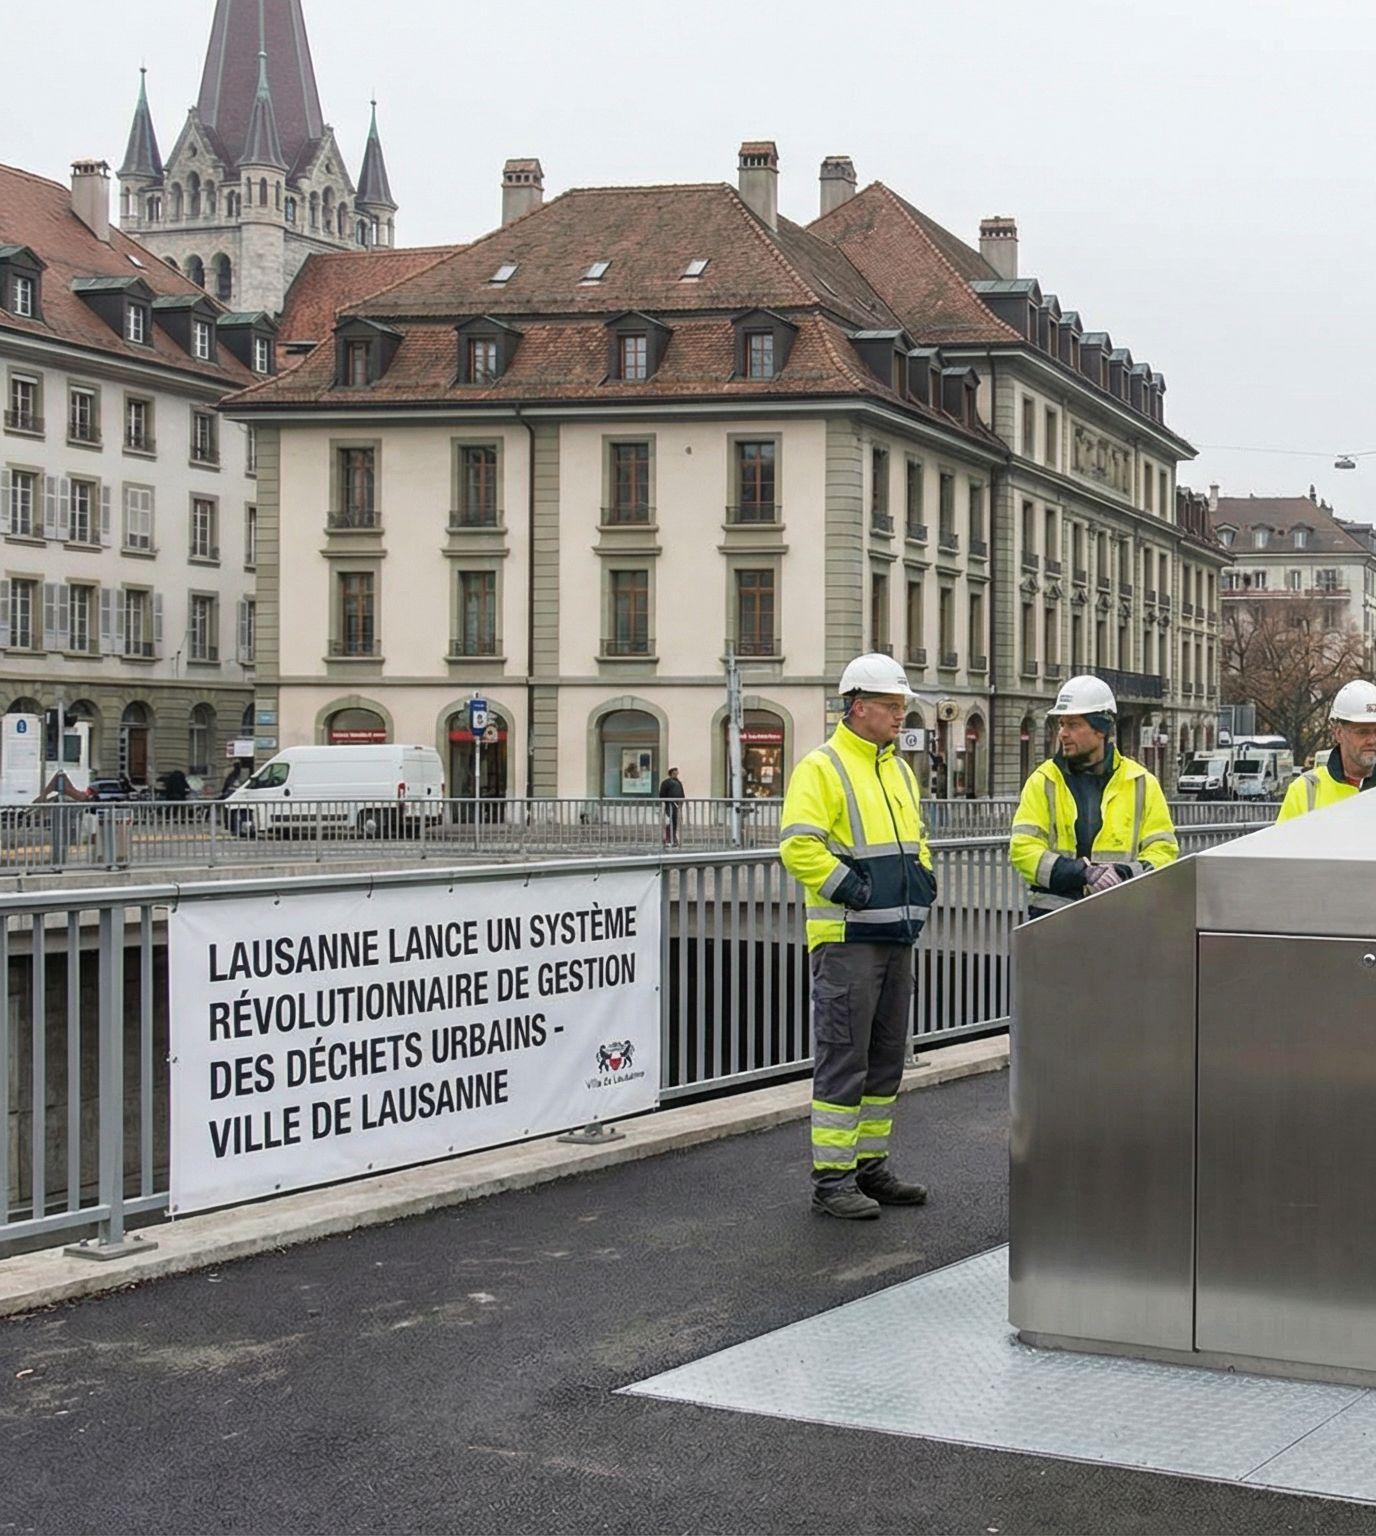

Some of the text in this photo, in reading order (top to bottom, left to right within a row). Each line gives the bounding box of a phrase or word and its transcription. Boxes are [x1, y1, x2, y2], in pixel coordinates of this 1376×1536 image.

[209, 901, 637, 983] LAUSANNE LANCE UN SYSTÈME
[209, 952, 636, 1042] RÉVOLUTIONNAIRE DE GESTION
[210, 1053, 275, 1101] DES
[286, 1030, 423, 1088] DÉCHETS
[431, 1013, 547, 1065] URBAINS
[208, 1068, 509, 1159] VILLE DE LAUSANNE
